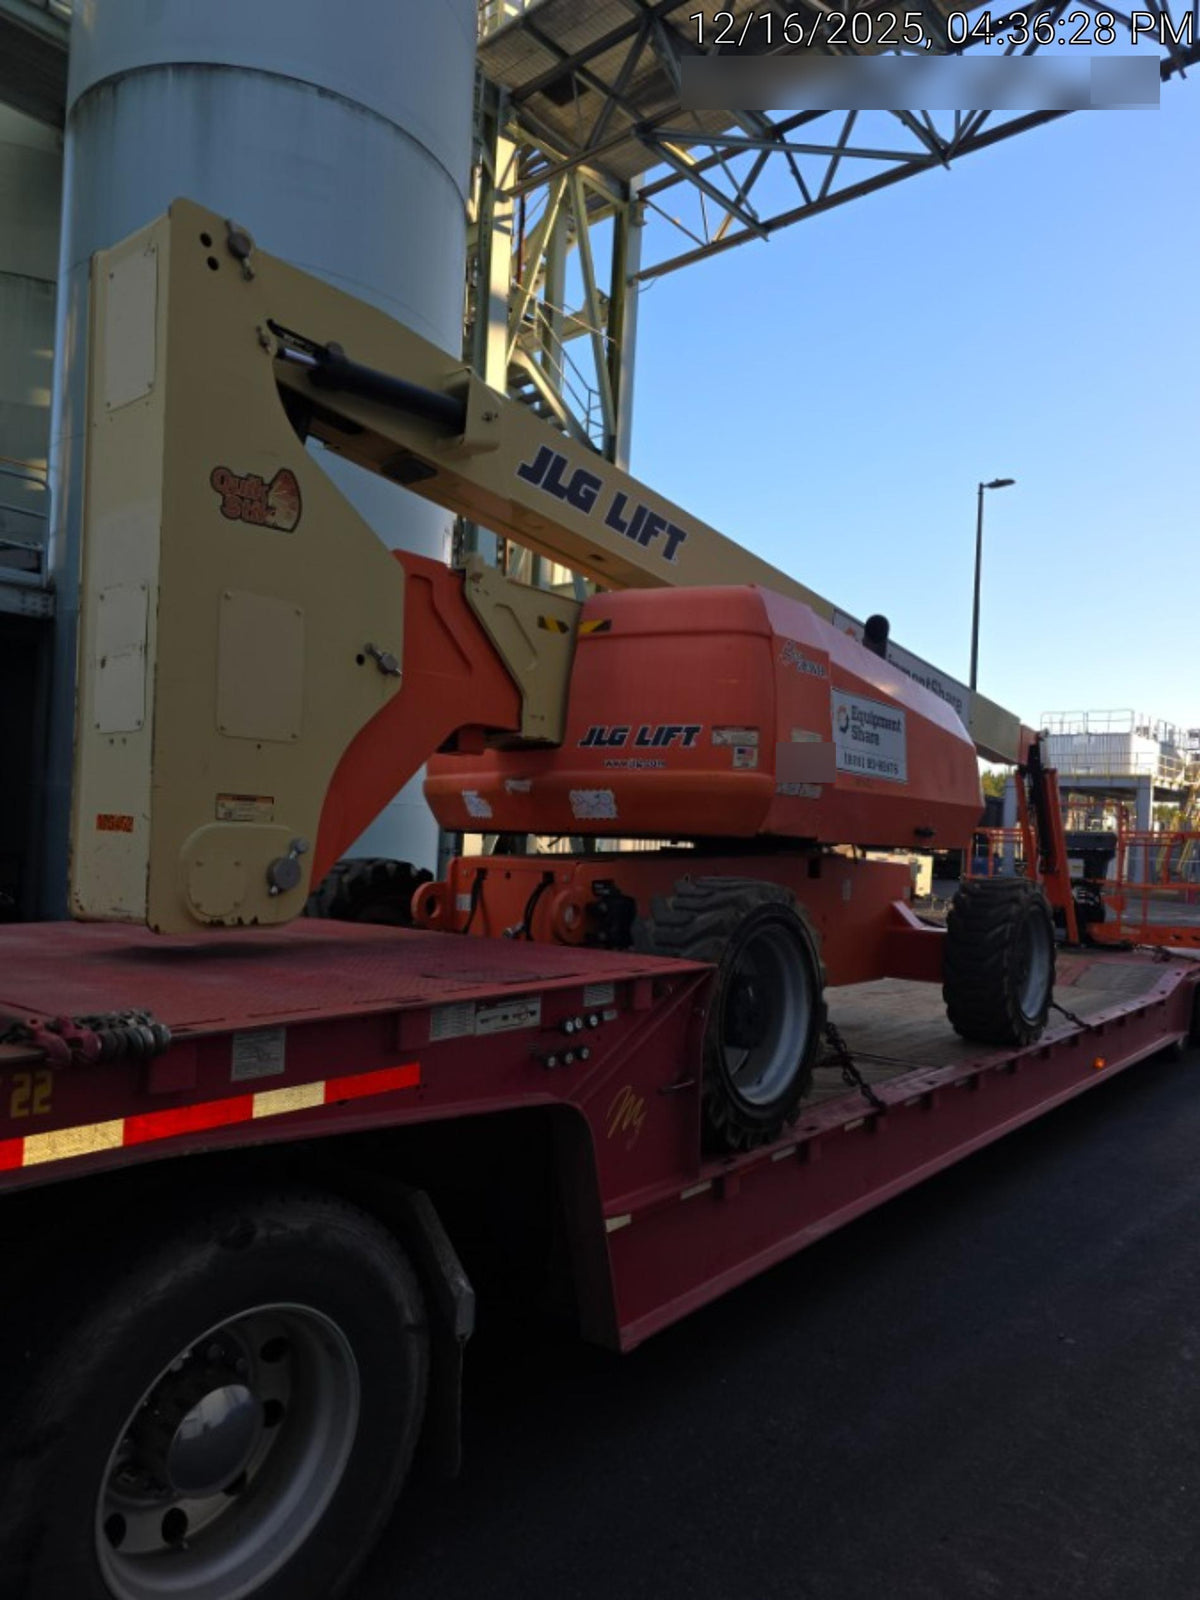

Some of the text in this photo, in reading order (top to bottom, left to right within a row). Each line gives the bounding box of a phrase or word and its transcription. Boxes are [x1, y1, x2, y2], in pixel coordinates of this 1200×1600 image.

[516, 445, 688, 562] JLG LIFT
[851, 705, 902, 732] Equipment
[579, 725, 630, 748] JLG
[635, 725, 703, 748] LIFT
[851, 725, 880, 746] Share
[10, 1070, 53, 1119] 22
